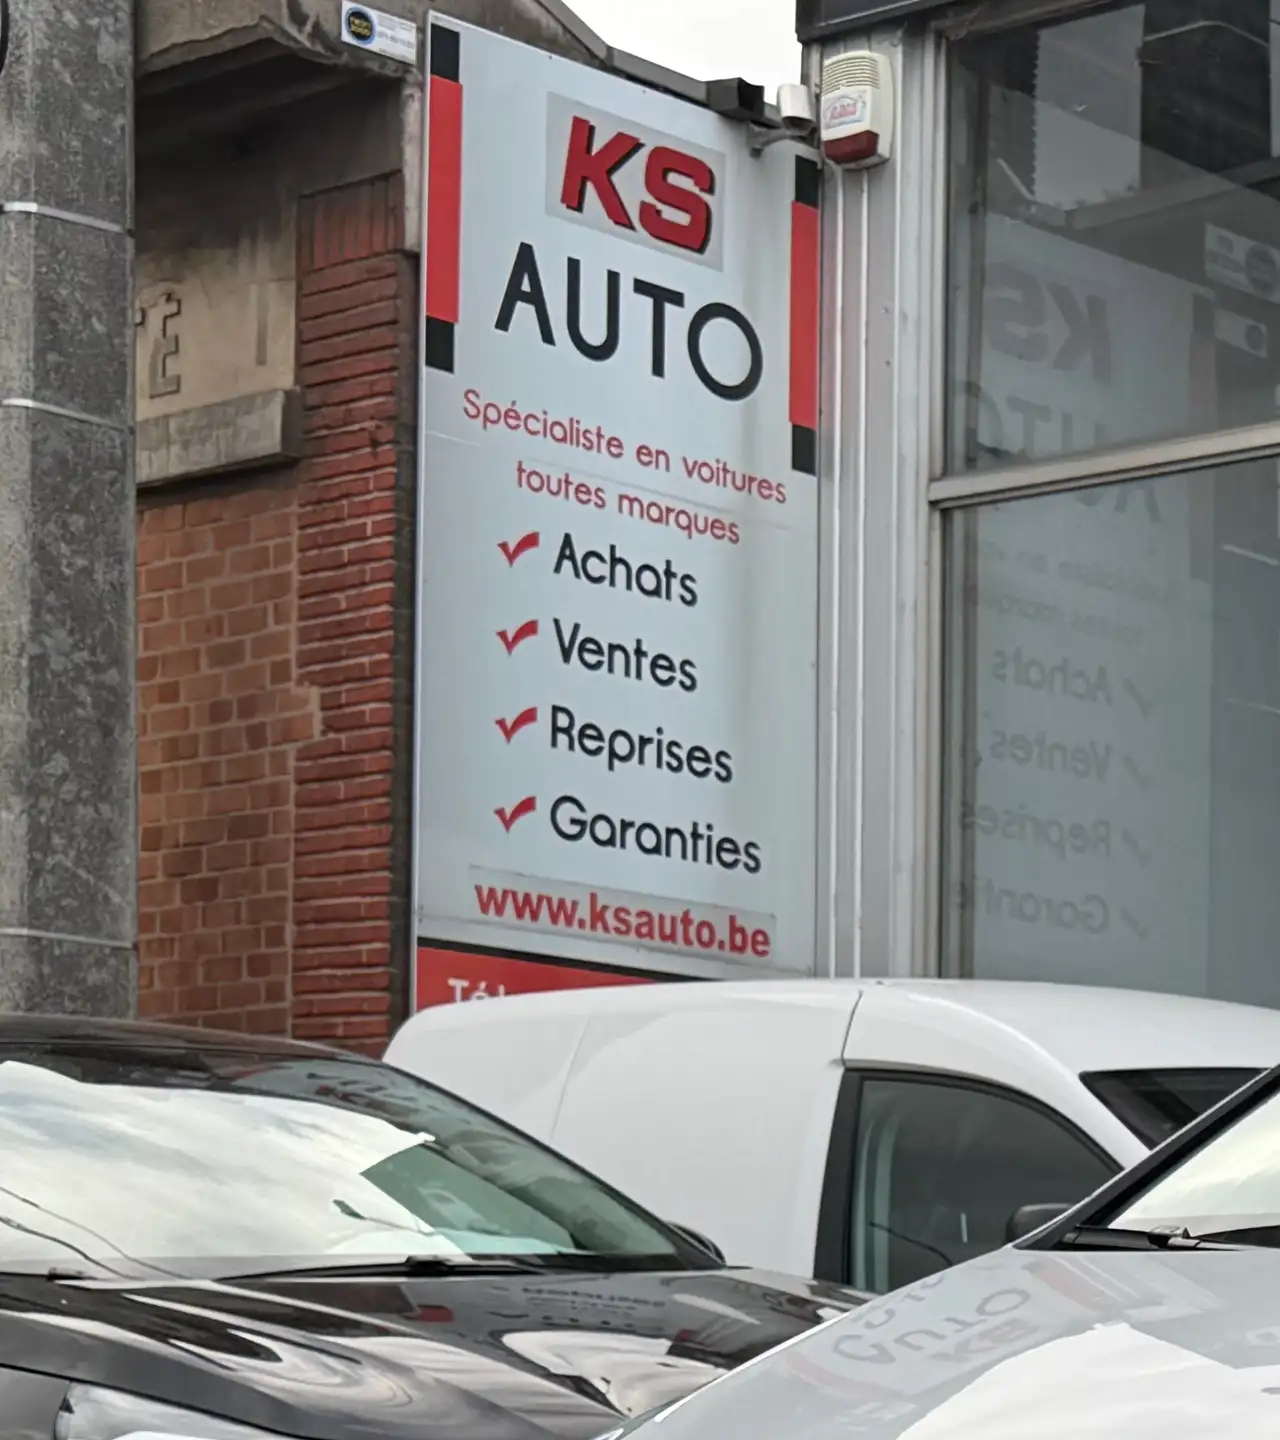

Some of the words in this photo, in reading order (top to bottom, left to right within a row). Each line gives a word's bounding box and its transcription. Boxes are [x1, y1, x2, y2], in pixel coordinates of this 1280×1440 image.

[560, 115, 716, 256] KS
[494, 241, 763, 401] AUTO
[462, 388, 625, 460] Spécialiste
[635, 443, 672, 474] en
[682, 455, 788, 505] voitures
[516, 460, 607, 511] toutes
[617, 492, 741, 545] marques
[553, 532, 698, 607] Achats
[553, 617, 697, 692] Ventes
[550, 704, 733, 784] Reprises
[550, 795, 761, 874] Garanties
[474, 884, 771, 957] www.ksauto.be
